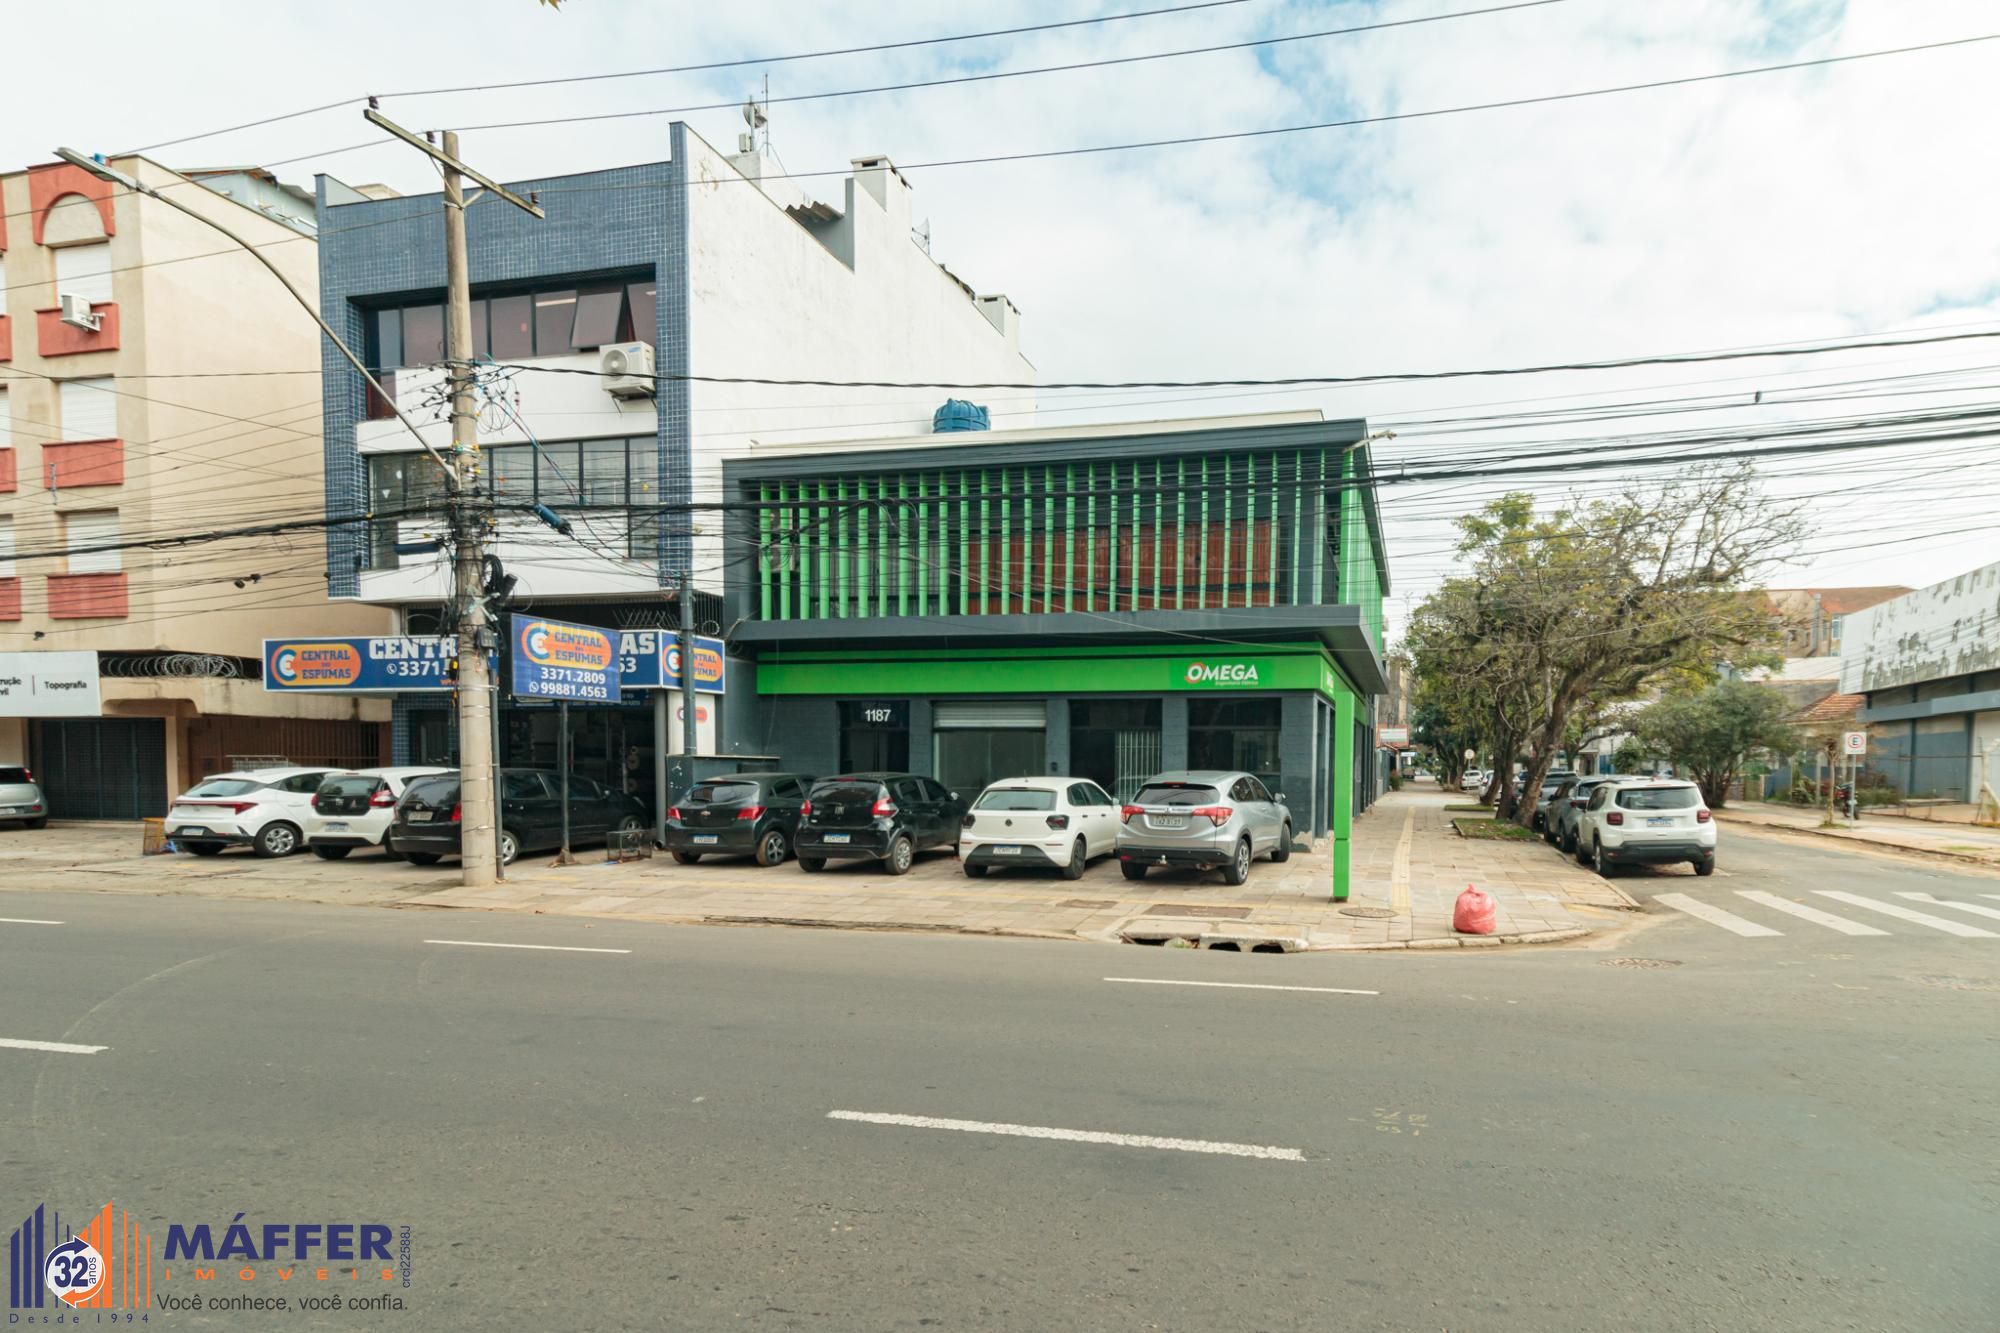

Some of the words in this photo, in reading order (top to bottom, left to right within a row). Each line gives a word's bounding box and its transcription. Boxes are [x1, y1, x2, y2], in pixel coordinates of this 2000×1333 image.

[554, 631, 603, 648] CENTRAL
[301, 650, 350, 661] CENTRAL
[368, 638, 458, 660] CENTR
[555, 650, 603, 665] ESPUMAS
[302, 668, 351, 679] ESPUMAS
[541, 667, 606, 684] 3371.2809
[1187, 663, 1258, 681] OMEGA
[44, 680, 88, 690] Topografia
[540, 682, 608, 699] 99881.4563
[865, 709, 892, 722] 1187
[1852, 737, 1859, 745] E
